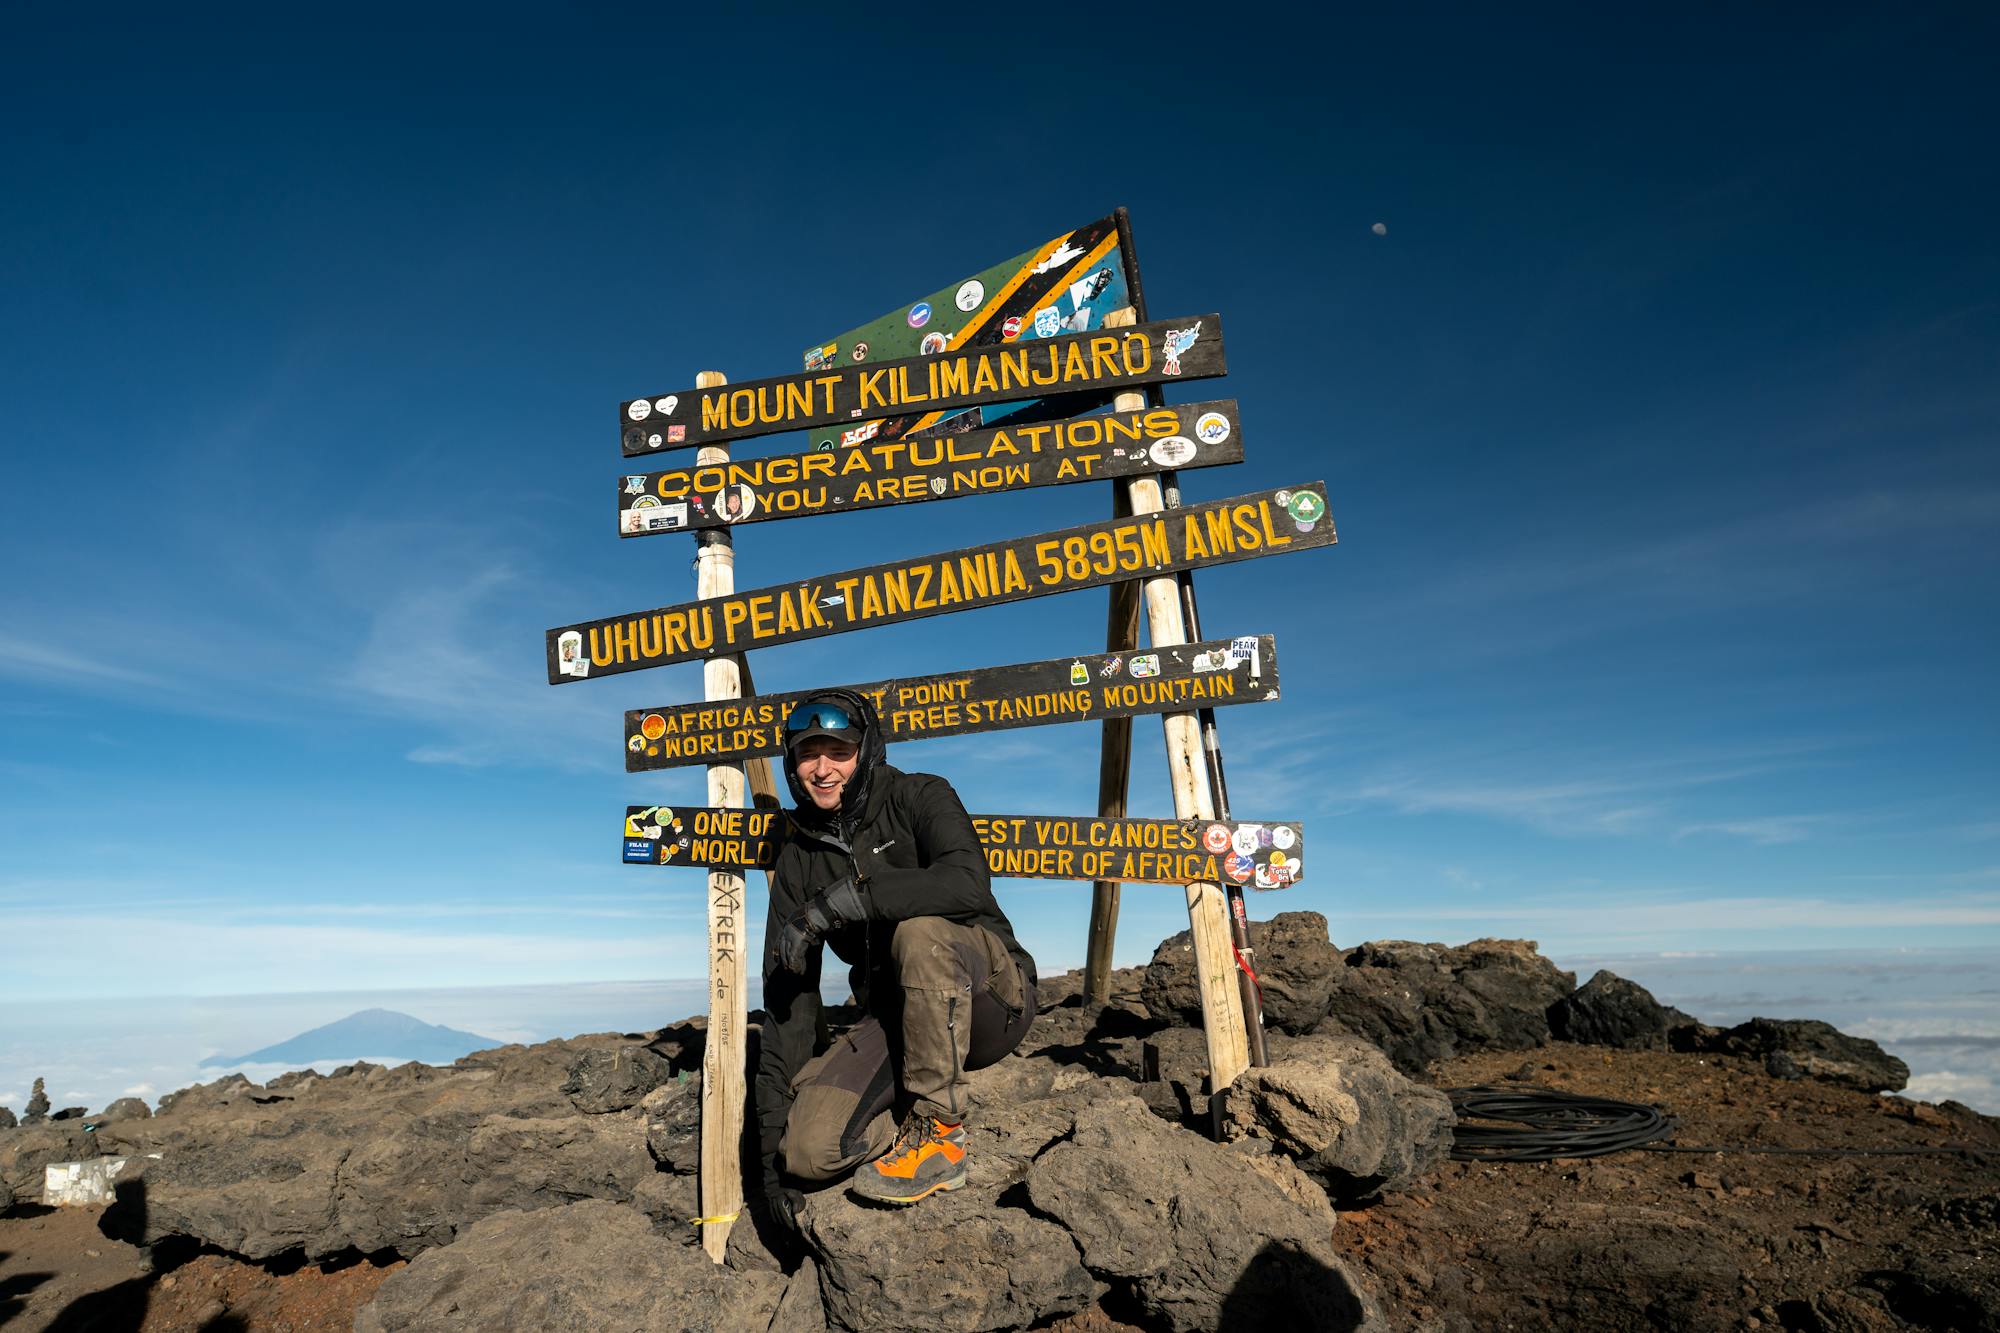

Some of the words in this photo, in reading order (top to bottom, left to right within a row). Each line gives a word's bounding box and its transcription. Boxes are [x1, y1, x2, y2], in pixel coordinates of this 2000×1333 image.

[702, 375, 843, 430] MOUNT
[859, 332, 1152, 410] KILIMANJARO
[657, 409, 1181, 498] CONGRATULATIONS
[756, 486, 828, 514] YOU
[853, 474, 929, 503] ARE
[952, 462, 1031, 492] NOW
[1057, 453, 1102, 479] AT
[589, 600, 715, 668] UHURU
[722, 585, 834, 645] PEAK,
[835, 548, 1034, 622] TANZANIA,
[1036, 519, 1173, 586] 5895M
[1185, 499, 1294, 562] AMSL
[1232, 640, 1257, 650] PEAK
[666, 703, 775, 735] AFRICAS
[899, 678, 972, 707] POINT
[666, 728, 768, 758] WORLD'S
[892, 704, 960, 733] FREE
[965, 688, 1093, 724] STANDING
[1104, 673, 1235, 709] MOUNTAIN
[691, 838, 774, 866] WORLD
[983, 847, 1075, 876] ONDER
[1082, 850, 1116, 878] OF
[1123, 851, 1220, 881] AFRICA
[694, 811, 744, 837] ONE
[748, 813, 776, 837] OF
[972, 819, 1027, 844] EST
[1034, 821, 1198, 851] VOLCANOES
